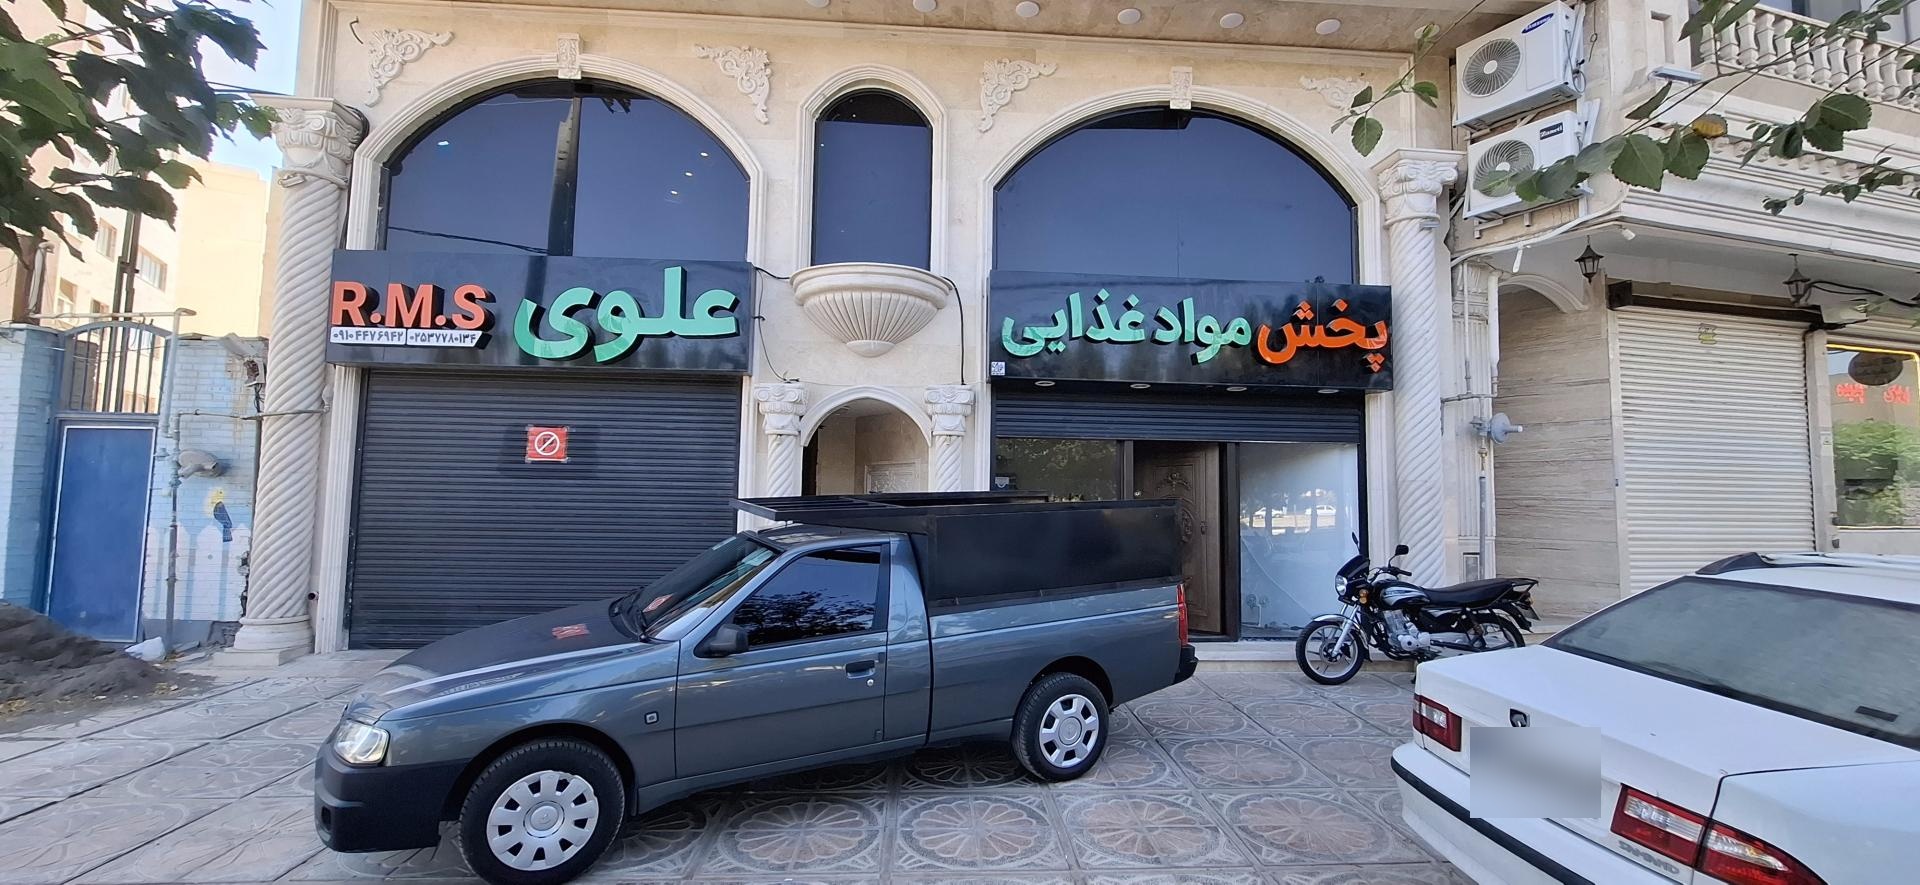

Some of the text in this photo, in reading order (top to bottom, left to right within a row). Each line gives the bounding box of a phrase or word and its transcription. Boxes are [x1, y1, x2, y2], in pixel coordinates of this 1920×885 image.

[331, 281, 488, 329] R.M.S
[513, 266, 739, 363] علوی
[1002, 288, 1388, 373] پخش مواد غذایی
